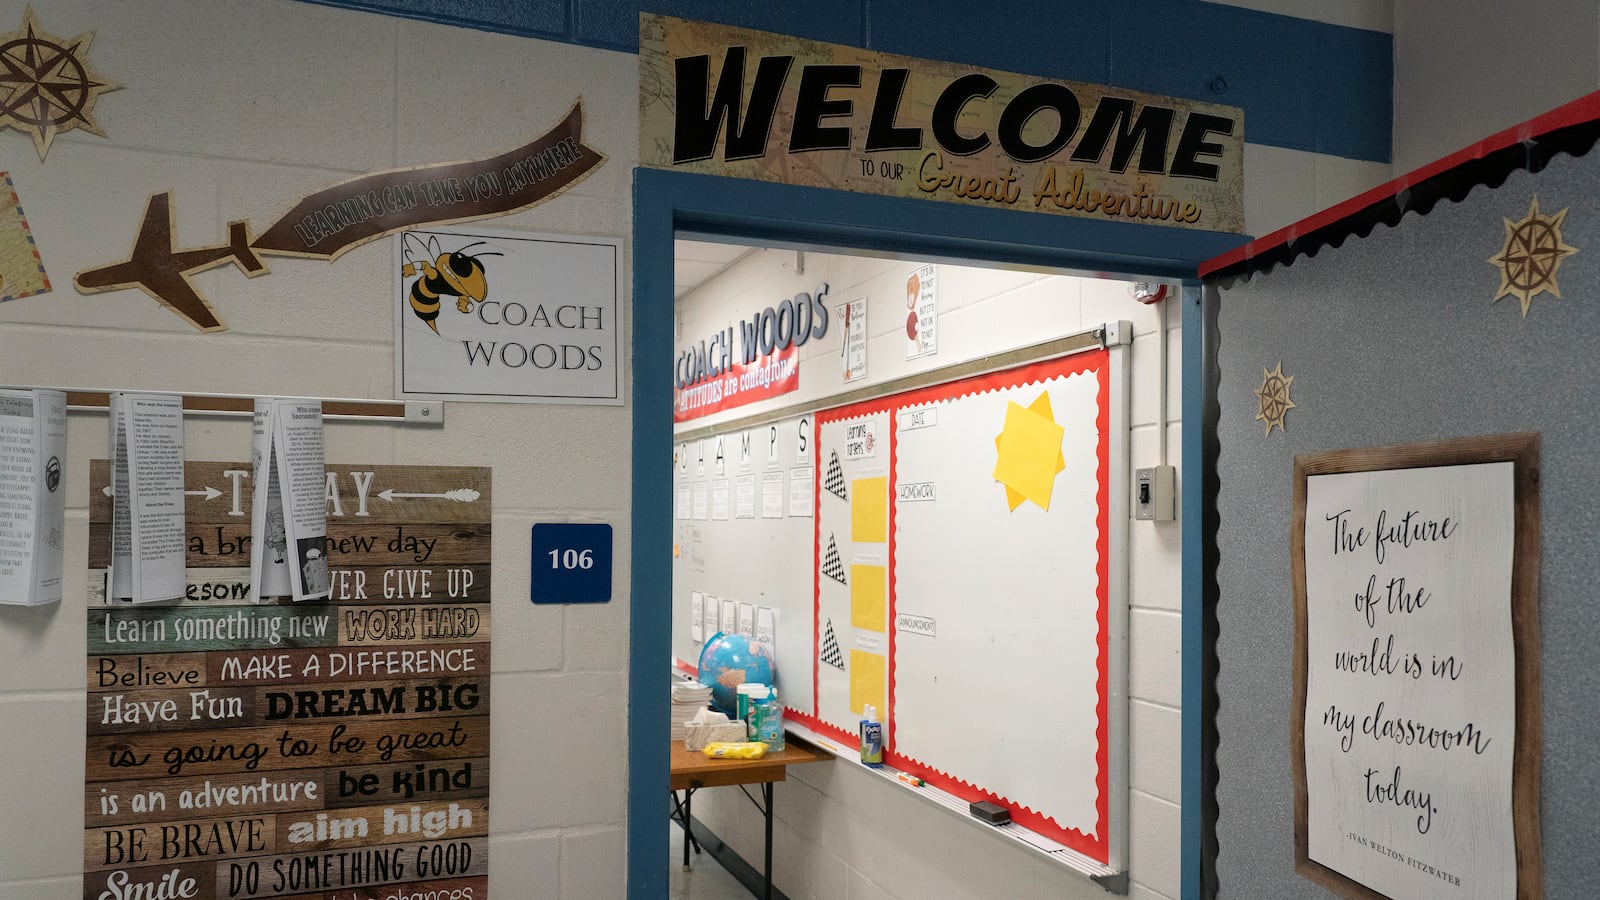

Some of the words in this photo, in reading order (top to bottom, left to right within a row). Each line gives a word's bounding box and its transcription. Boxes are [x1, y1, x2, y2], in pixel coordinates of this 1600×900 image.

[672, 45, 1235, 182] WELCOME
[293, 190, 385, 248] LEARNING
[383, 181, 417, 212] CAN
[419, 177, 465, 207] TAKE
[464, 171, 503, 203] YOU
[501, 136, 583, 196] ANYWHERE
[860, 159, 875, 177] TO
[881, 161, 904, 180] OUR
[915, 152, 1021, 204] Great
[1033, 166, 1202, 223] Adventure
[477, 300, 604, 331] COACH
[675, 327, 733, 390] COACH
[739, 281, 829, 365] WOODS
[462, 340, 603, 372] WOODS
[679, 378, 723, 413] ATTITUDES
[724, 376, 738, 398] are
[911, 411, 925, 427] DATE
[716, 438, 724, 465] A
[741, 432, 750, 457] M
[770, 426, 777, 457] P
[798, 417, 809, 453] S
[223, 470, 375, 517] TAY
[901, 483, 935, 499] HOMEWORK
[189, 535, 208, 555] a
[387, 528, 437, 562] day
[1325, 509, 1371, 555] The
[1375, 509, 1458, 565] future
[548, 548, 594, 569] 106
[383, 569, 434, 599] GIVE
[447, 568, 474, 598] UP
[1355, 574, 1383, 628] of
[1386, 577, 1431, 616] the
[105, 612, 166, 643] Learn
[174, 610, 281, 644] something
[289, 615, 328, 638] new
[346, 609, 416, 642] WORK
[421, 607, 480, 639] HARD
[900, 614, 935, 633] ANNOUNCEMENTS
[100, 657, 198, 687] Believe
[221, 654, 293, 681] MAKE
[303, 653, 321, 677] A
[328, 648, 476, 676] DIFFERENCE
[1335, 634, 1400, 677] world
[1404, 652, 1423, 680] is
[1432, 654, 1463, 681] in
[101, 694, 178, 725] Have
[190, 690, 243, 721] Fun
[265, 687, 406, 721] DREAM
[415, 683, 480, 712] BIG
[1323, 703, 1356, 753] my
[1362, 701, 1493, 755] classroom
[109, 746, 151, 769] is
[164, 735, 268, 775] going
[278, 730, 318, 757] to
[329, 724, 366, 755] be
[376, 721, 468, 761] great
[101, 788, 118, 815] is
[131, 791, 166, 813] an
[179, 776, 318, 809] adventure
[339, 770, 380, 798] be
[392, 763, 472, 799] kind
[1363, 766, 1438, 834] today.
[103, 828, 148, 865] BE
[160, 818, 266, 861] BRAVE
[287, 813, 368, 844] aim
[383, 804, 473, 839] high
[230, 861, 260, 897] DO
[273, 848, 405, 892] SOMETHING
[416, 841, 472, 877] GOOD
[1370, 840, 1405, 864] WELTON
[1407, 855, 1462, 888] FITZWATER
[98, 868, 199, 900] Smile
